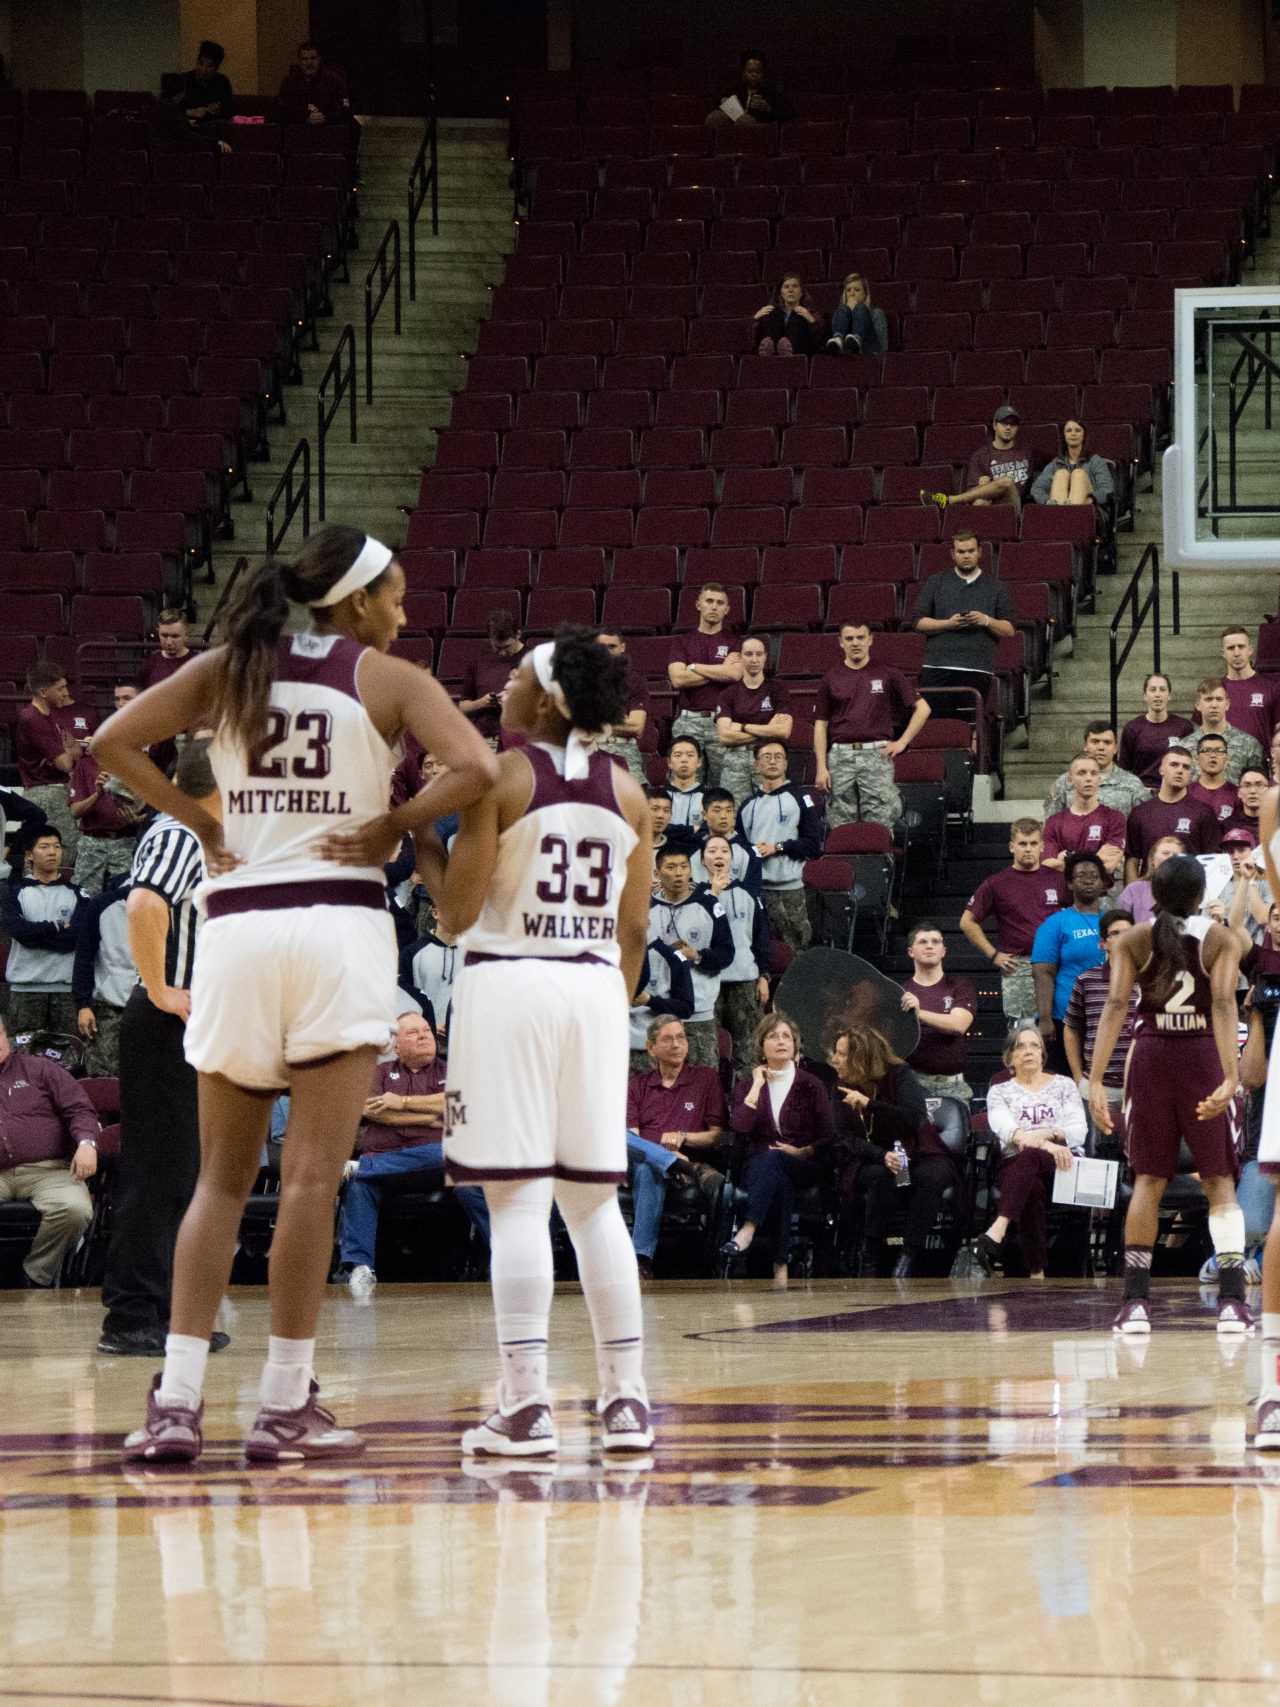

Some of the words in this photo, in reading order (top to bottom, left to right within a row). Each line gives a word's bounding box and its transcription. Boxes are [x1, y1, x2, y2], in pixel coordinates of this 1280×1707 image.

[247, 706, 332, 779] 23
[228, 789, 351, 815] MITCHELL
[536, 833, 615, 907] 33
[522, 912, 615, 940] WALKER
[1164, 970, 1196, 1013] 2
